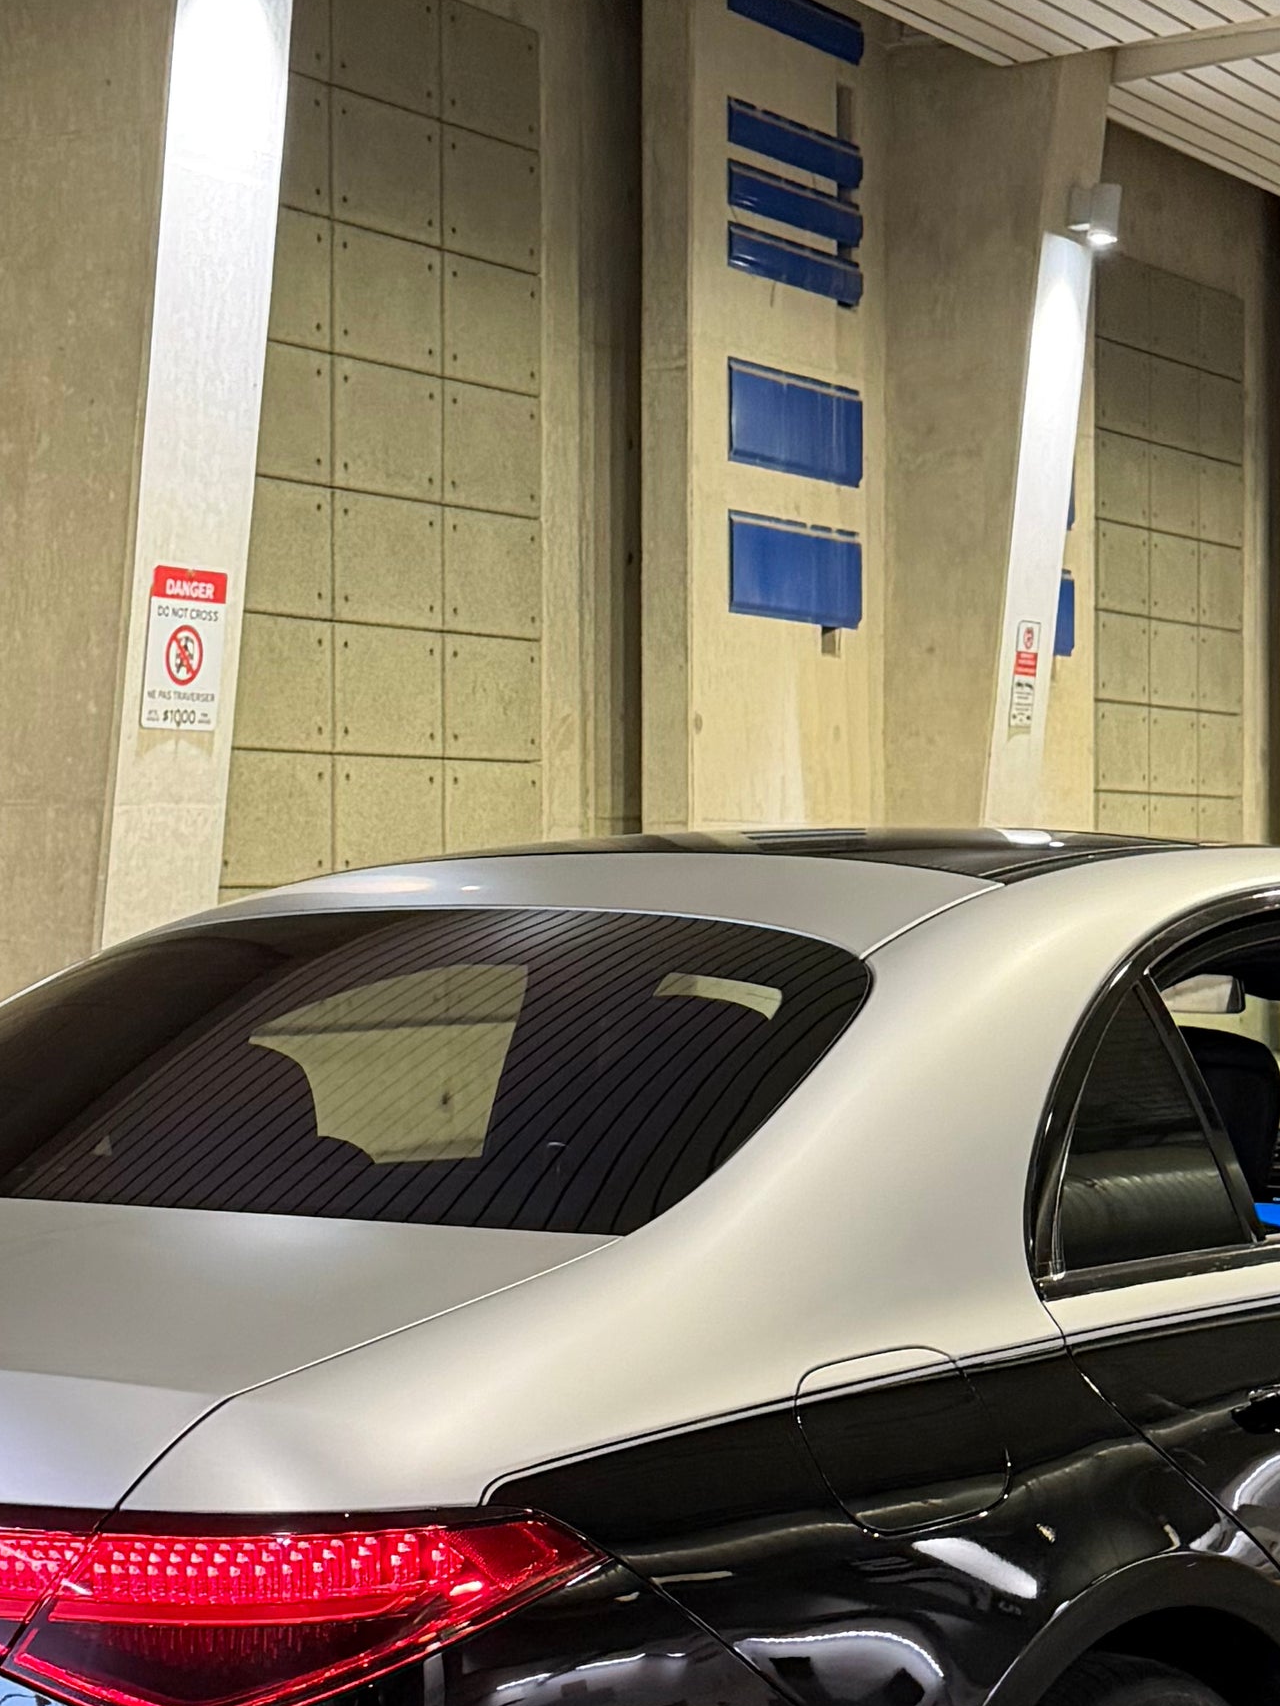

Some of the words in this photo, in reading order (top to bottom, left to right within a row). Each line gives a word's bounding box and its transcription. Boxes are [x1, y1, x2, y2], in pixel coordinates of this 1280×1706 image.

[165, 578, 215, 599] DANGER
[157, 605, 170, 618] DO
[171, 607, 189, 620] NOT
[190, 608, 219, 622] CROSS
